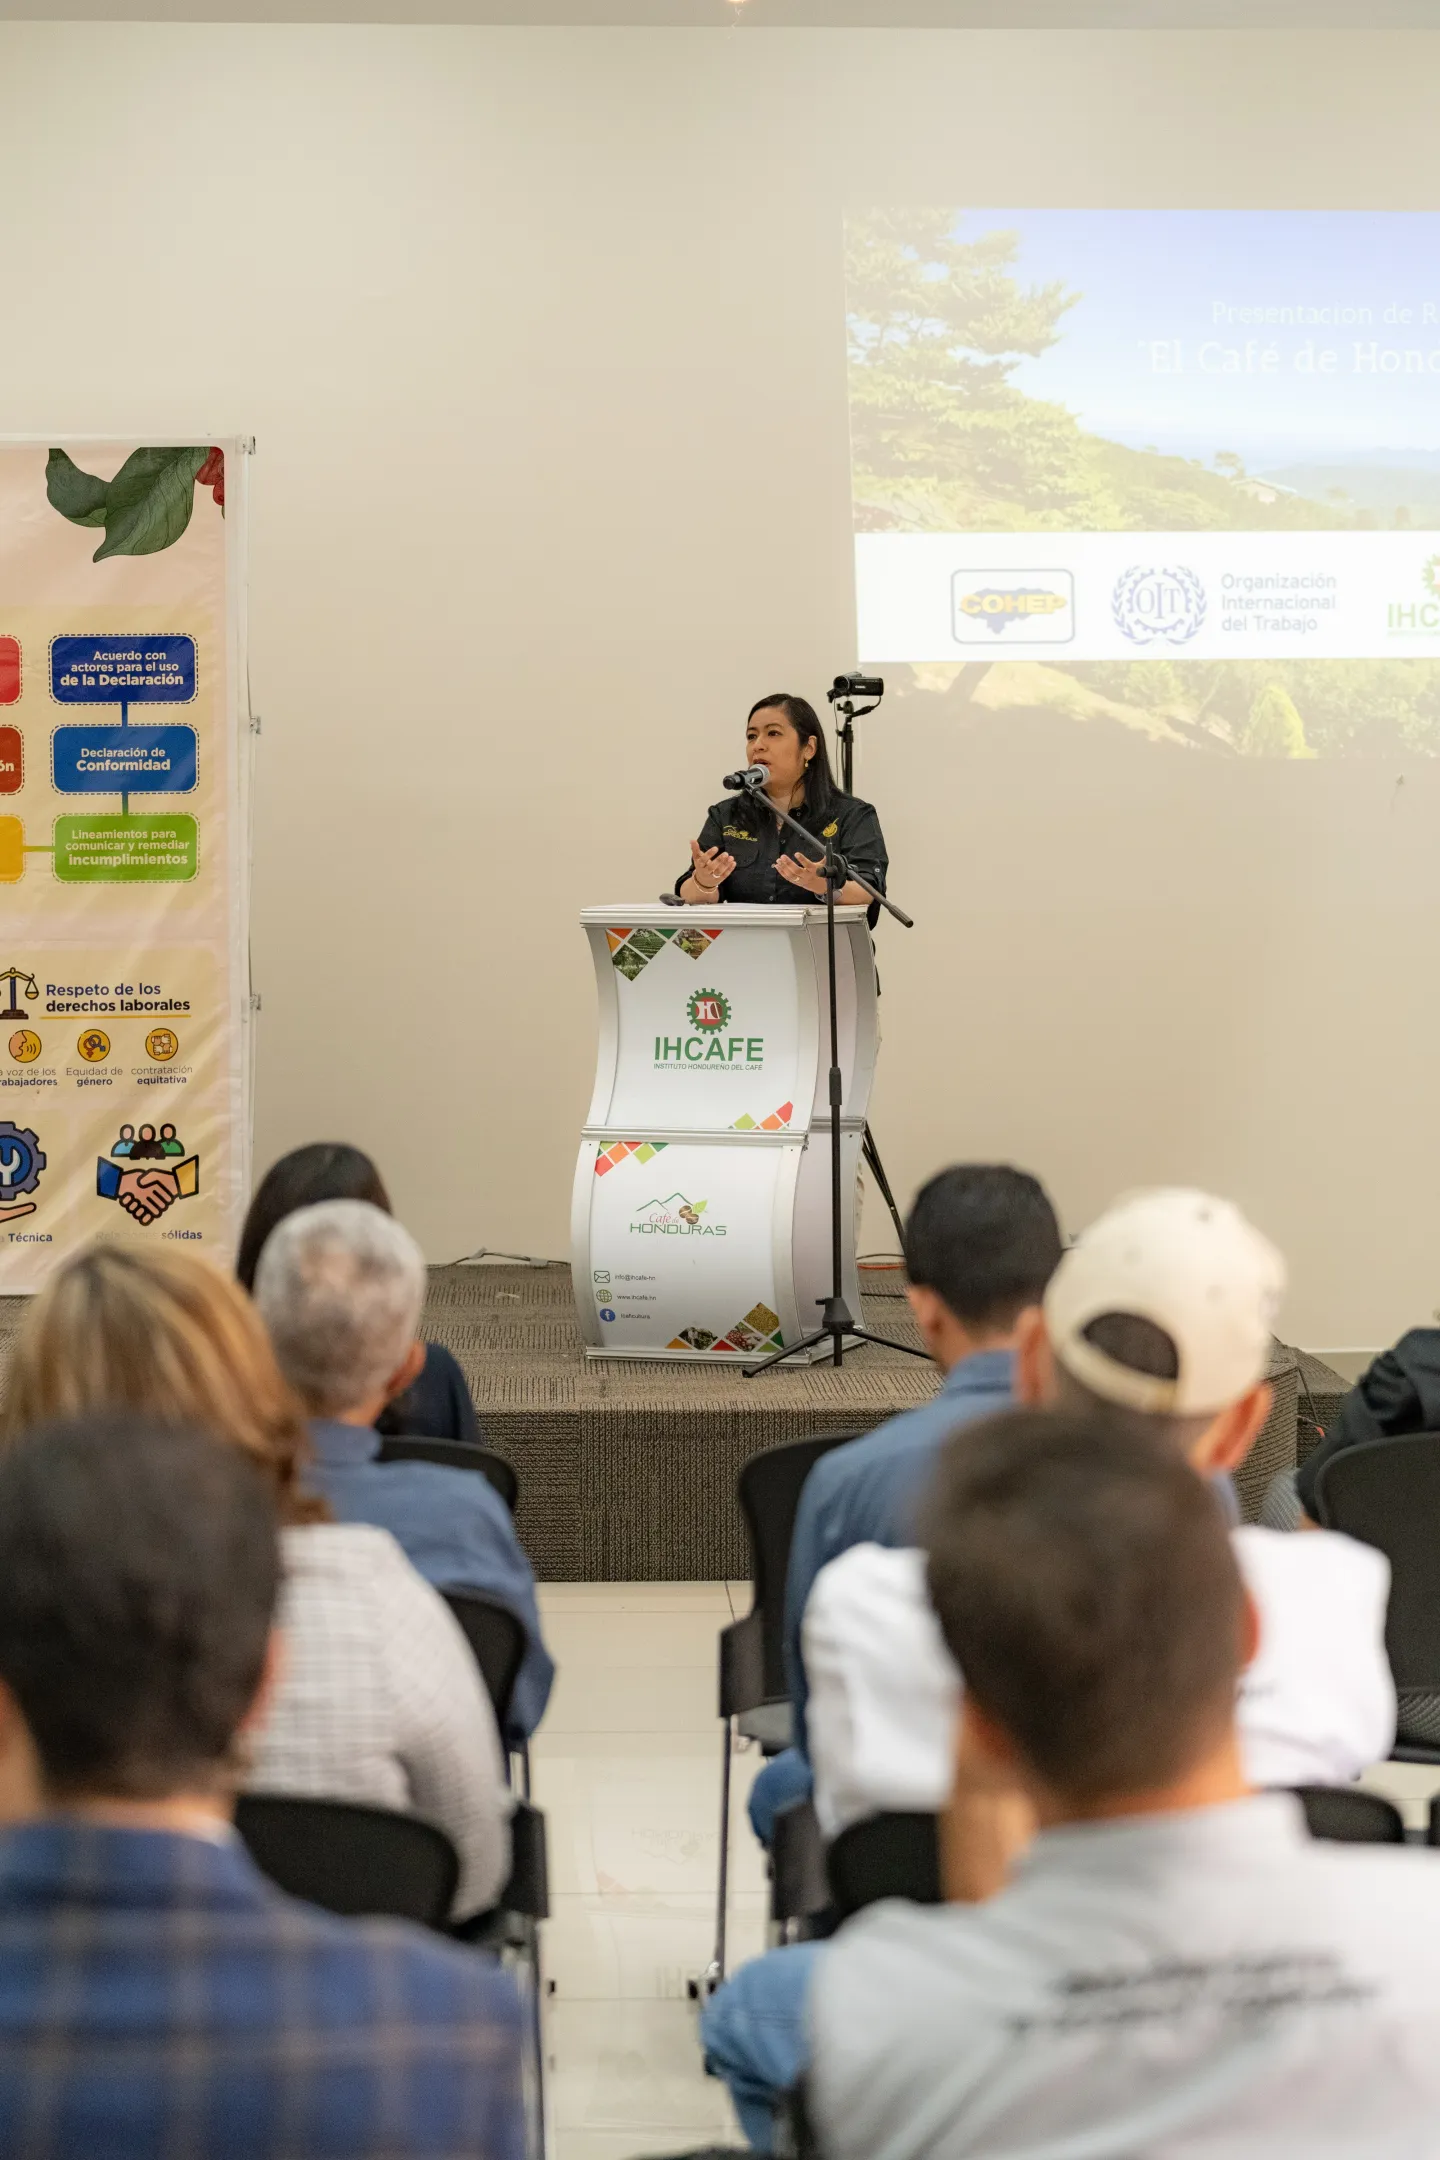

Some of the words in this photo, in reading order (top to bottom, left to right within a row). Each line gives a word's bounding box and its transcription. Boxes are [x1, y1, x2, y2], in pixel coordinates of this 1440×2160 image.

[1383, 302, 1413, 325] de
[1196, 338, 1281, 374] Café
[1293, 338, 1339, 374] de
[1221, 573, 1337, 592] Organización
[959, 592, 1067, 615] COHEP
[1135, 582, 1182, 621] OIT
[1222, 594, 1336, 610] Internacional
[1222, 614, 1248, 631] del
[1254, 614, 1318, 635] Trabajo
[93, 651, 142, 661] Acuerdo
[145, 652, 167, 660] con
[71, 662, 113, 672] actores
[117, 663, 143, 674] para
[146, 662, 156, 671] el
[159, 663, 179, 671] uso
[60, 675, 79, 686] de
[82, 674, 95, 685] la
[99, 673, 184, 686] Declaración
[81, 747, 147, 758] Declaración
[151, 748, 166, 757] de
[76, 759, 171, 772] Conformidad
[72, 830, 148, 839] Lineamientos
[151, 831, 177, 841] para
[65, 841, 125, 850] comunicar
[128, 842, 135, 852] y
[138, 840, 190, 850] remediar
[69, 854, 188, 866] incumplimientos
[46, 984, 110, 998] Respeto
[114, 983, 133, 995] de
[139, 983, 161, 995] los
[46, 999, 116, 1012] derechos
[120, 998, 190, 1011] laborales
[654, 1036, 764, 1062] IHCAFE
[26, 1068, 39, 1076] de
[42, 1067, 57, 1076] los
[66, 1067, 108, 1077] Equidad
[110, 1067, 124, 1076] de
[131, 1065, 193, 1075] contratación
[687, 1063, 730, 1071] HONDUREÑO
[76, 1077, 113, 1087] género
[137, 1075, 187, 1086] equitativa
[649, 1211, 672, 1225] Café
[161, 1230, 202, 1240] sólidas
[629, 1222, 727, 1236] HONDURAS
[8, 1231, 53, 1242] Técnica
